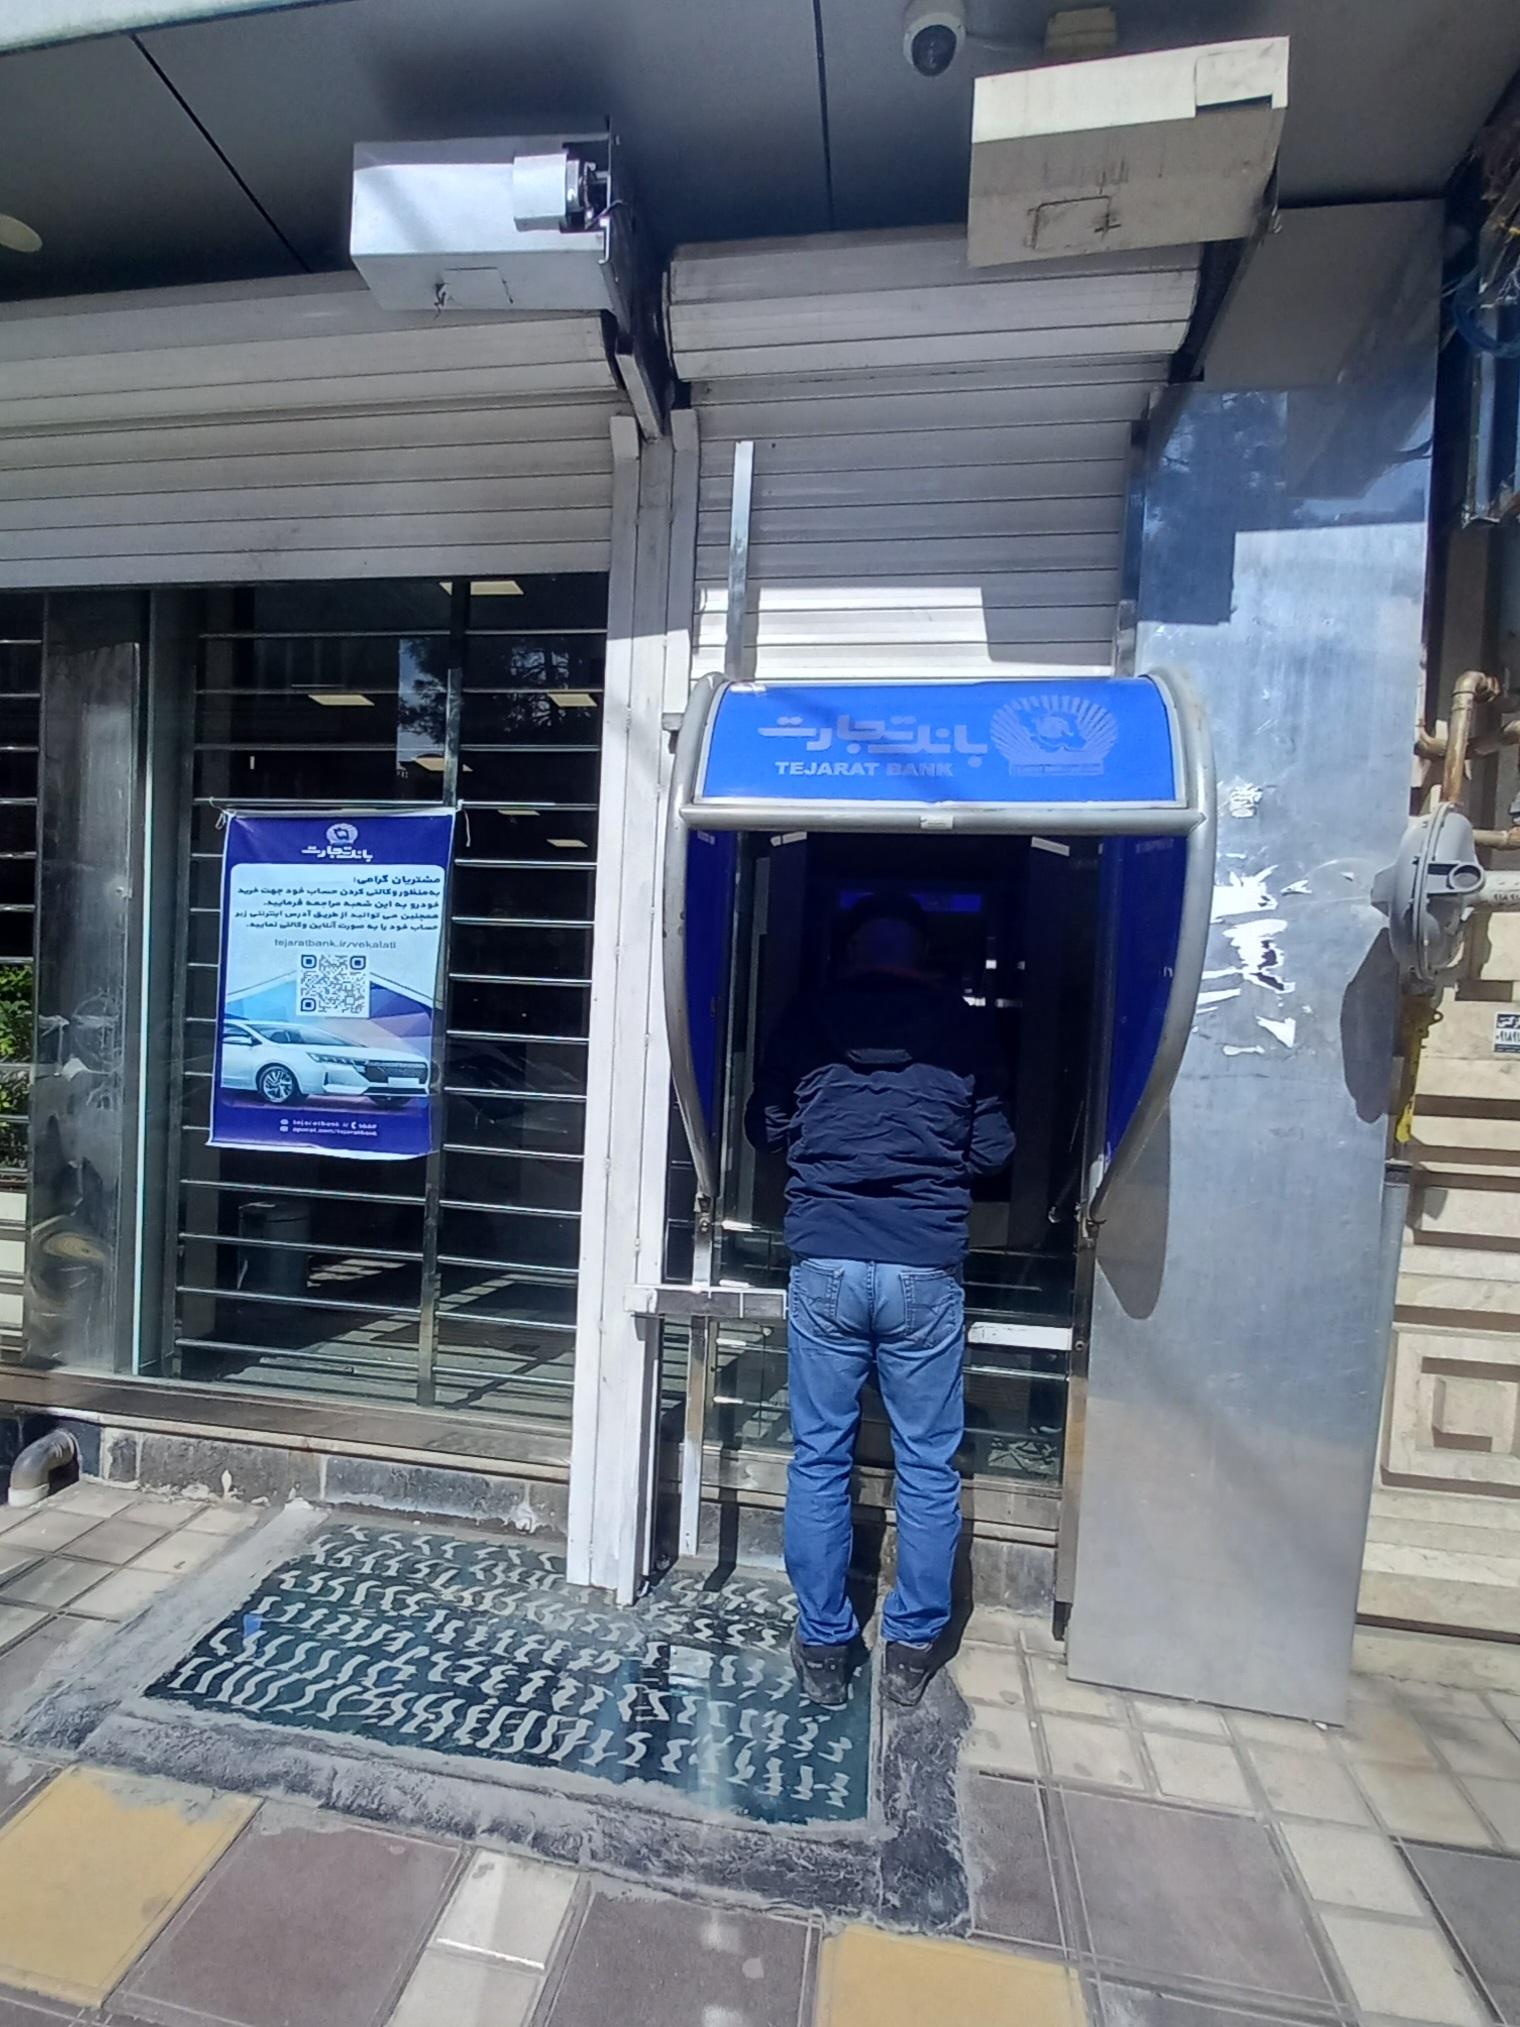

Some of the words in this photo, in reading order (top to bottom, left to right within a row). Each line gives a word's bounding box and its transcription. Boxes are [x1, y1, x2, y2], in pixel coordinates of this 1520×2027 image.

[757, 714, 917, 754] تجارت
[867, 725, 989, 768] بانک
[775, 761, 880, 777] TEJARAT
[886, 762, 954, 777] BANK
[301, 845, 353, 859] تجارت
[336, 849, 373, 862] بانک
[391, 875, 440, 885] مشتریان
[237, 886, 259, 895] خرید
[261, 887, 283, 896] جهت
[285, 886, 304, 896] خود
[306, 887, 338, 896] حساب
[340, 888, 364, 897] کردن
[305, 900, 341, 909] مراجعه
[343, 900, 372, 909] شعبه
[374, 900, 392, 909] این
[394, 901, 407, 909] به
[410, 901, 439, 909] خودرو
[234, 910, 247, 918] زیر
[249, 910, 283, 918] اینترنتی
[285, 909, 312, 919] آدرس
[313, 911, 338, 919] طریق
[400, 912, 439, 922] همچنین
[279, 921, 307, 930] وکالتی
[308, 920, 336, 930] آنلاین
[338, 923, 365, 931] صورت
[410, 924, 438, 932] حساب
